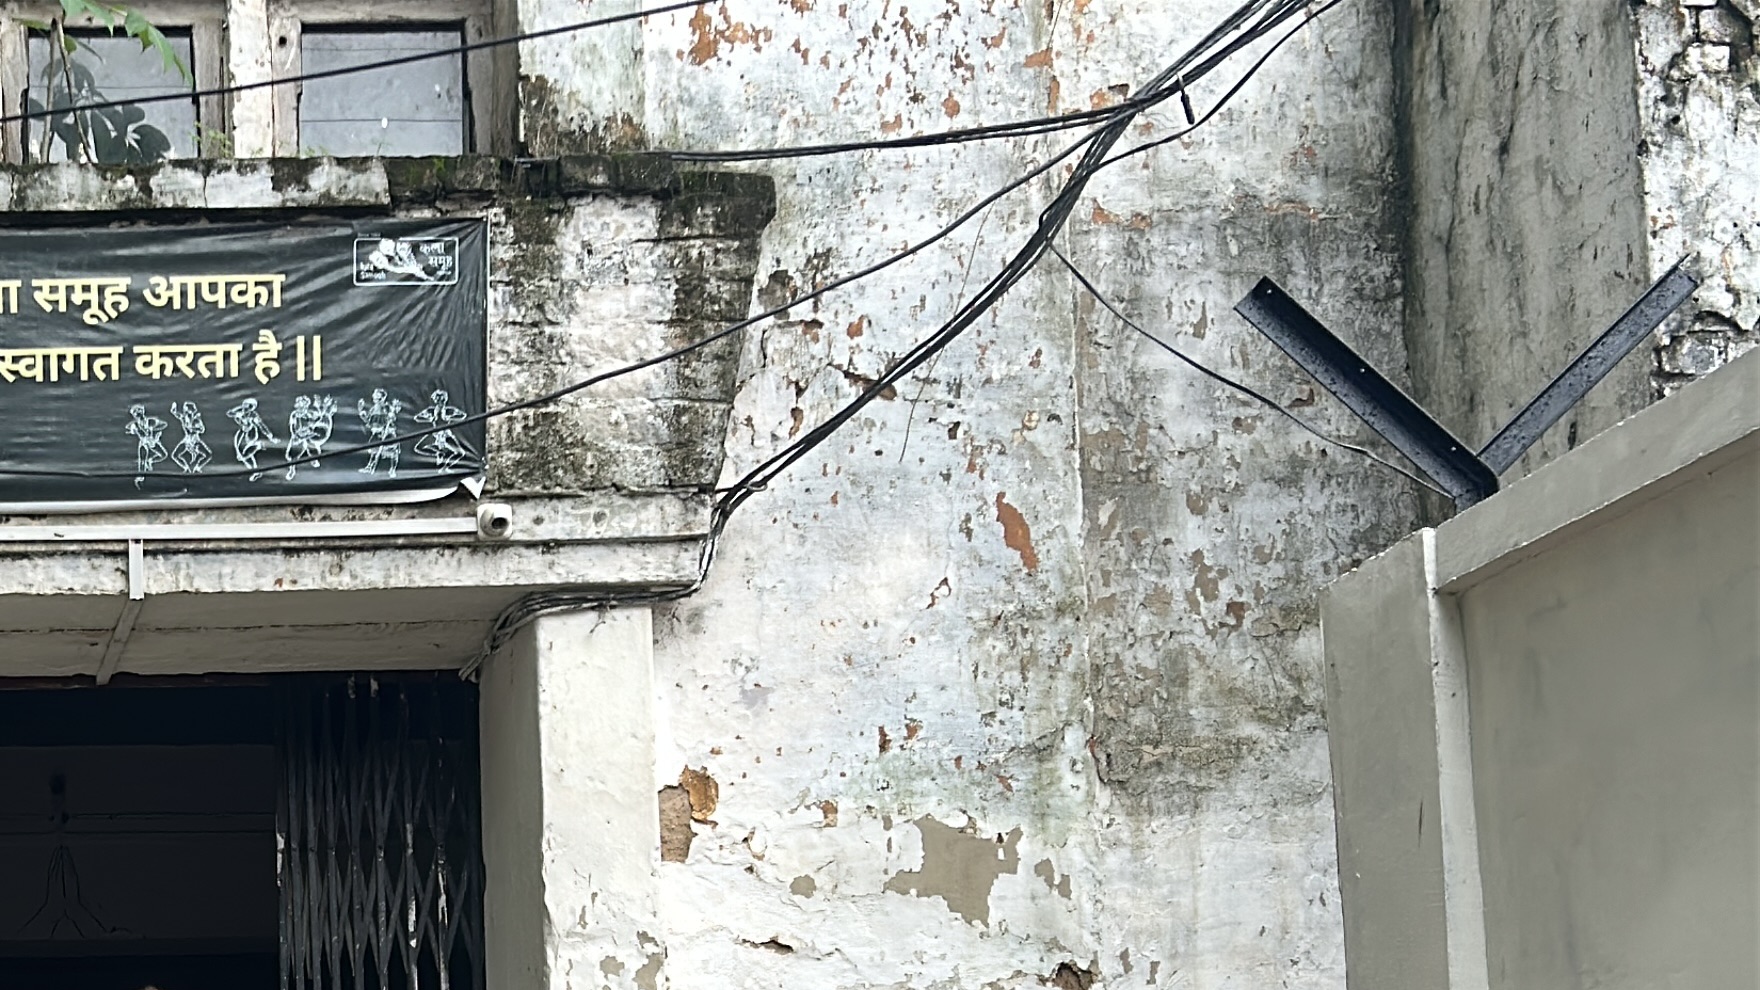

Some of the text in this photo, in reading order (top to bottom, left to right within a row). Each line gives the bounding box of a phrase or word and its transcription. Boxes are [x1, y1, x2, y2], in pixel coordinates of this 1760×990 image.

[32, 276, 130, 325] समूह
[143, 272, 286, 310] आपका
[134, 342, 242, 380] करता
[252, 329, 282, 385] है
